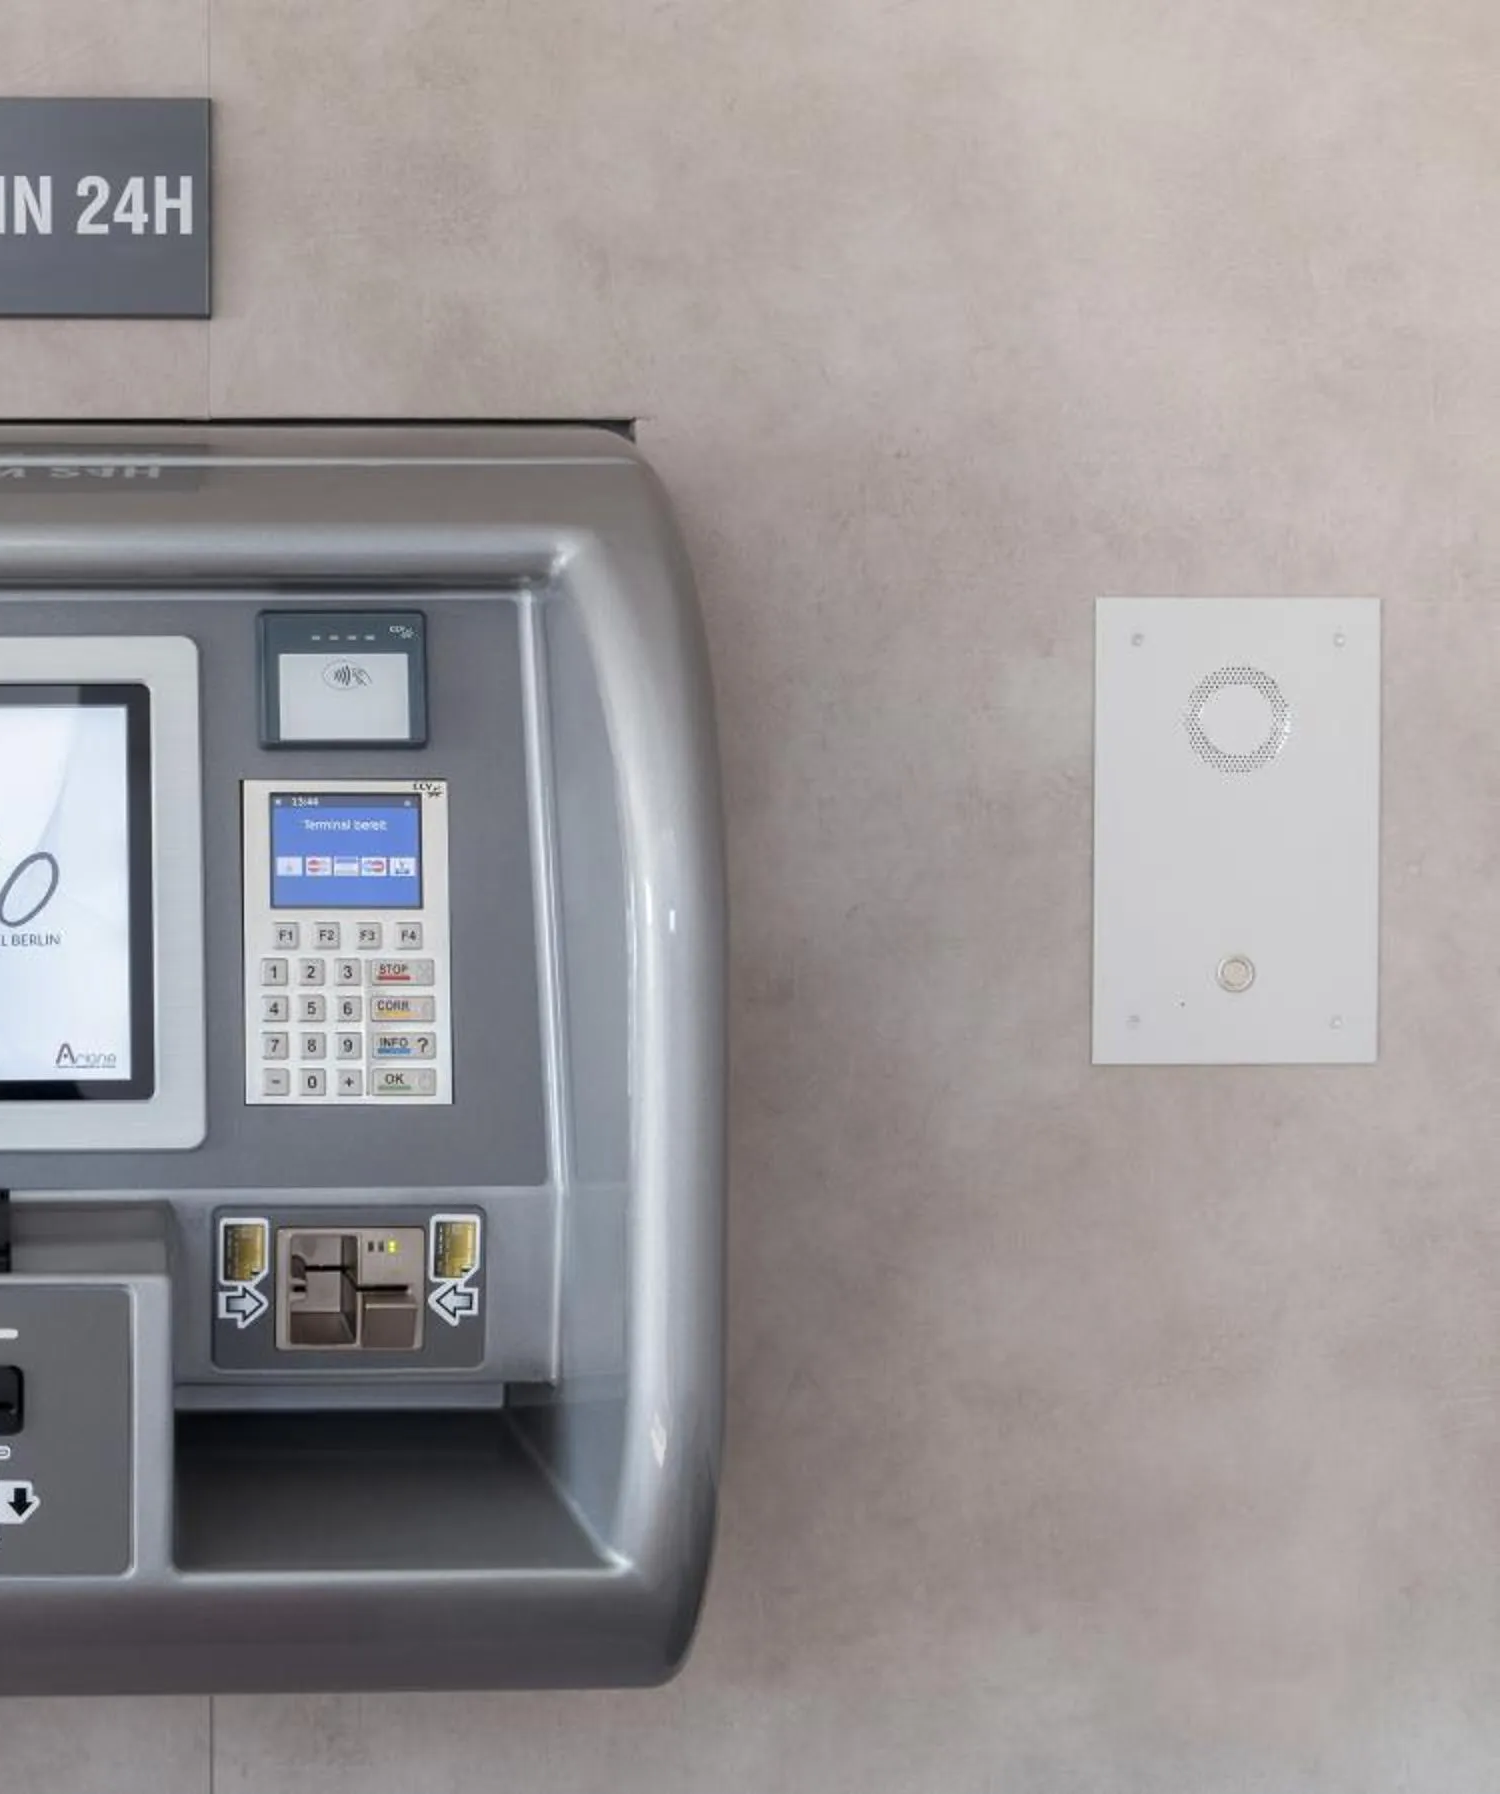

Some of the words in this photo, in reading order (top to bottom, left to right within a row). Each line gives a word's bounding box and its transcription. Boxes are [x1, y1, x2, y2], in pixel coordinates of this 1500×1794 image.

[75, 175, 194, 235] 24H
[11, 934, 61, 947] BERLIN
[278, 929, 294, 942] F1
[318, 929, 336, 942] F2
[359, 929, 376, 942] F3
[401, 929, 417, 942] F4
[270, 965, 278, 979] 1
[307, 965, 316, 979] 2
[343, 965, 353, 979] 3
[379, 963, 408, 975] STOP
[268, 1001, 279, 1016] 4
[307, 1001, 317, 1016] 5
[343, 1001, 353, 1016] 6
[270, 1038, 280, 1053] 7
[307, 1038, 317, 1053] 8
[343, 1038, 353, 1053] 9
[379, 1037, 409, 1048] INFO
[306, 1075, 317, 1089] 0
[384, 1073, 405, 1085] OK
